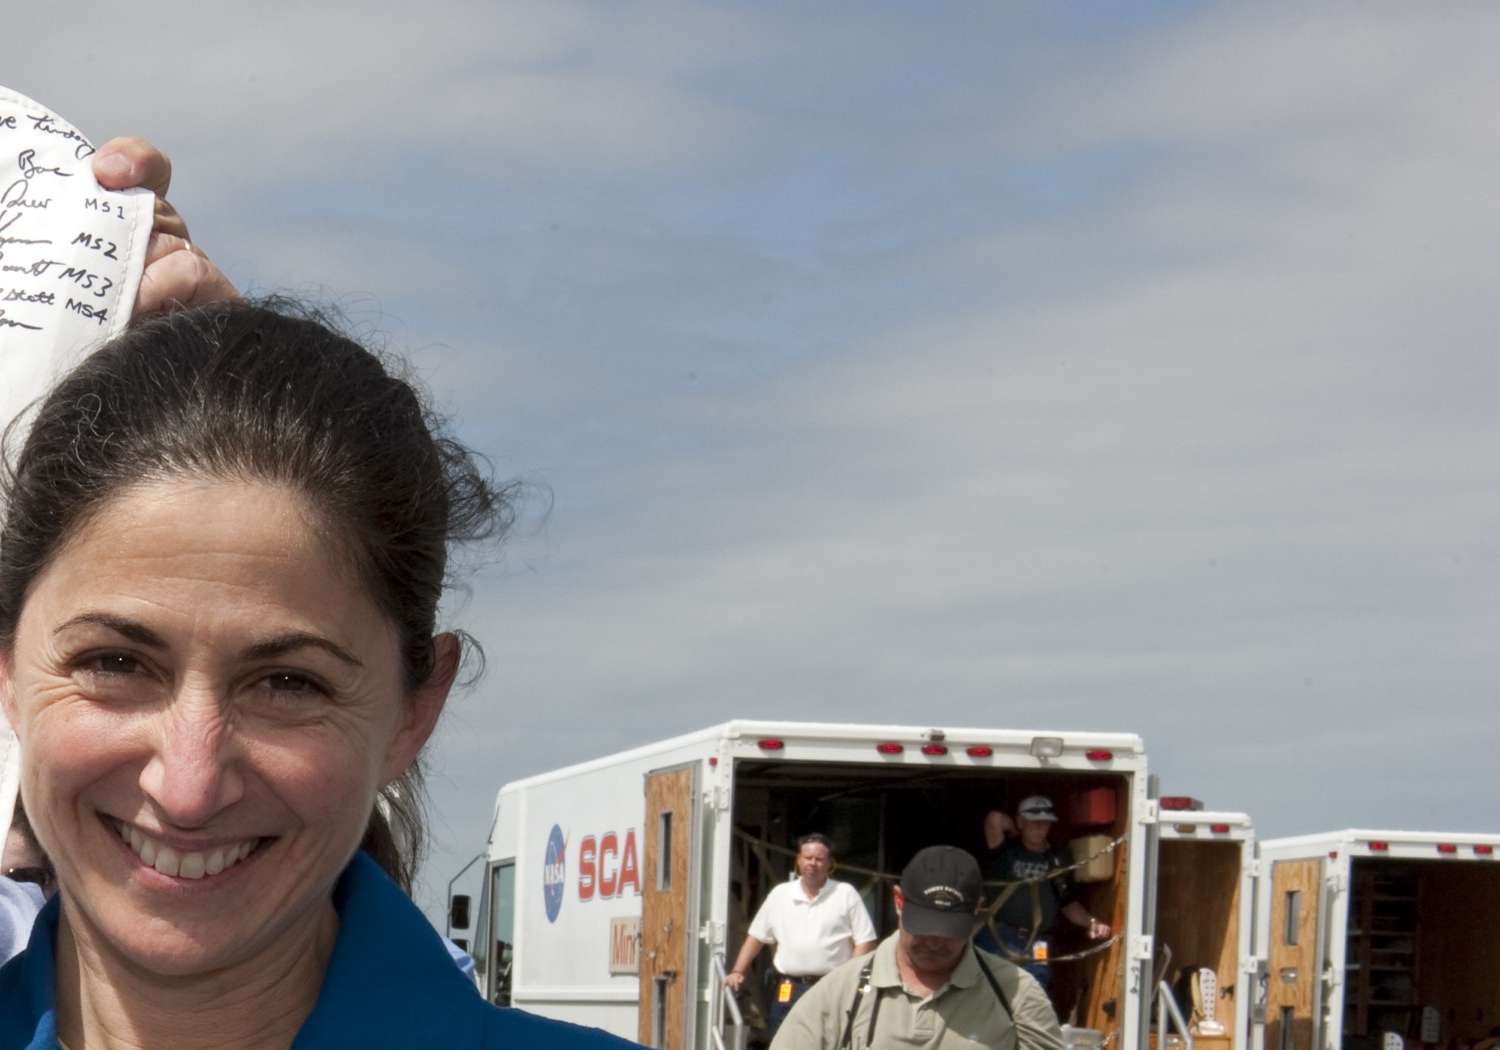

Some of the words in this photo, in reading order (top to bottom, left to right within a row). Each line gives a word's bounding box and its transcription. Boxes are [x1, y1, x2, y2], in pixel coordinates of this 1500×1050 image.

[70, 232, 118, 261] MS2
[58, 266, 114, 298] MS3
[65, 297, 109, 326] MS4
[578, 827, 643, 903] SCA
